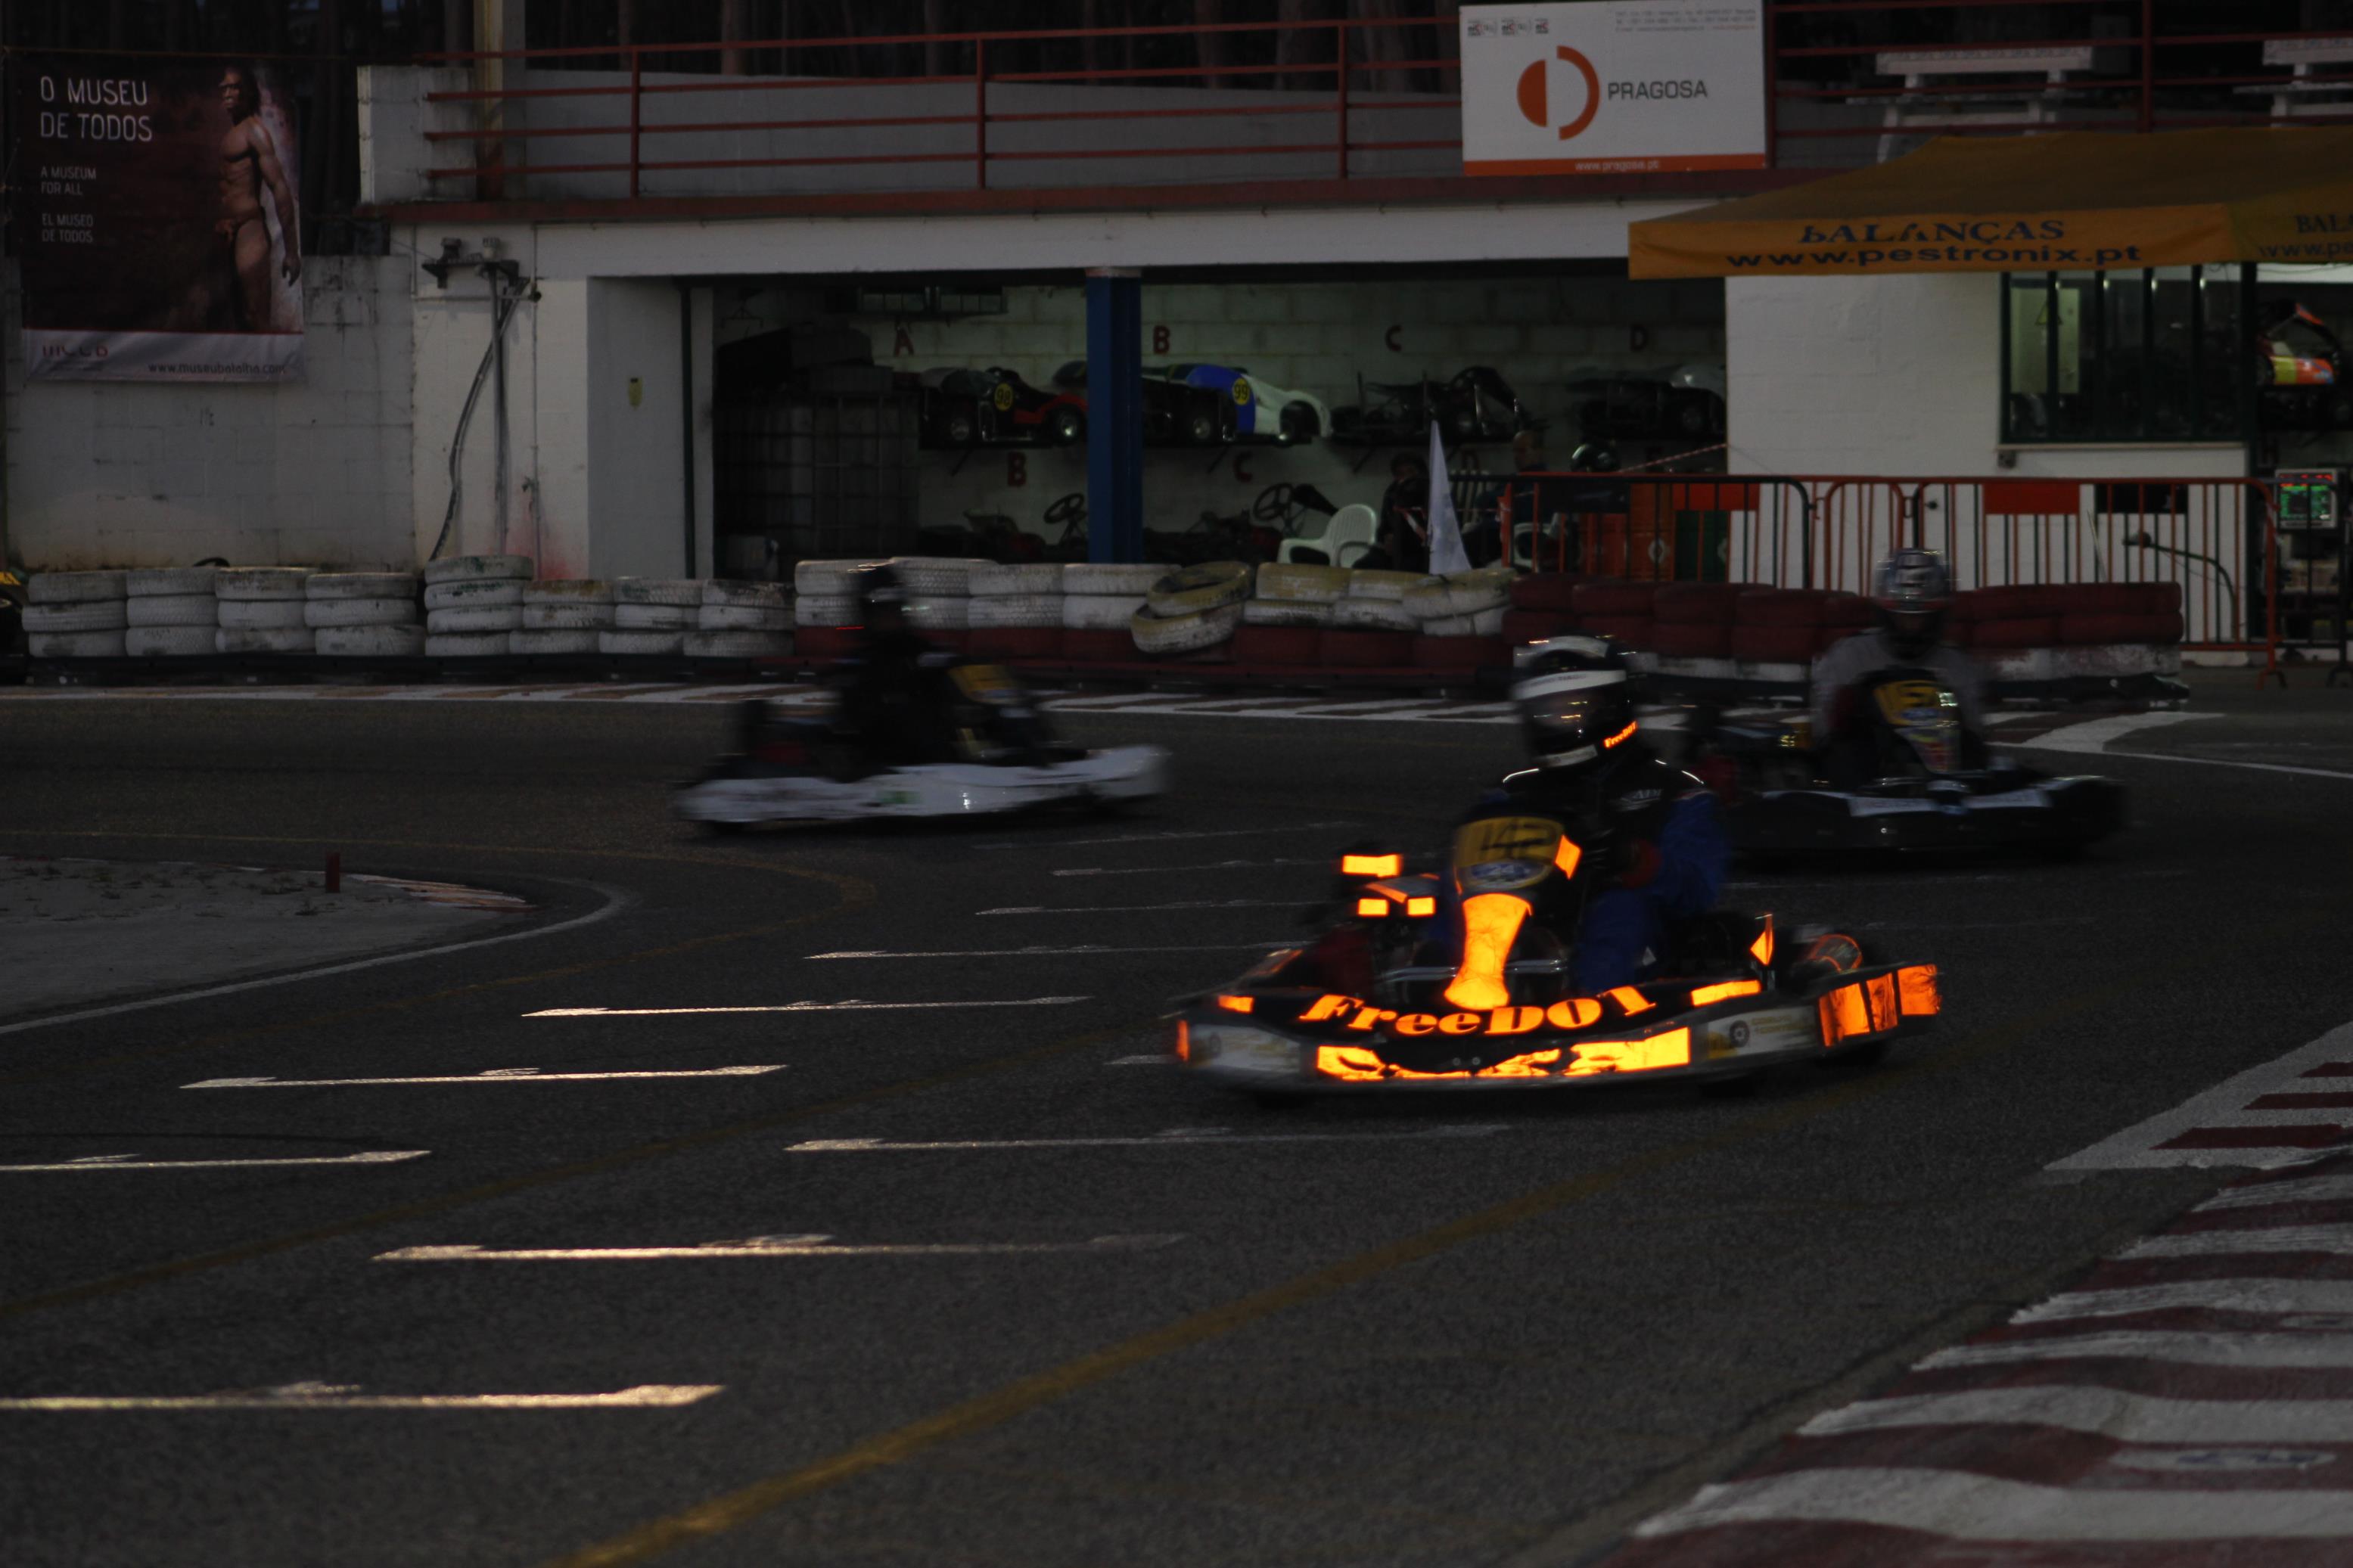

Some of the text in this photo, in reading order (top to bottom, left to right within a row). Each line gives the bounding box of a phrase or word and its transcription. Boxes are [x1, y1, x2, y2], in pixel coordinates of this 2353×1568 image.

[40, 76, 148, 106] O MUSEU
[1608, 80, 1708, 100] PRAGOSA
[40, 112, 153, 142] DE TODOS
[40, 166, 97, 180] A MUSEUM
[41, 182, 84, 196] FOR ALL
[42, 213, 94, 227] EL MUSEO
[42, 228, 94, 244] DE TODOS
[1727, 245, 2142, 266] www.pestronix.pt
[1153, 326, 1170, 354] B
[1385, 324, 1402, 352] C
[1630, 324, 1648, 351] D
[1007, 452, 1026, 486] B
[1298, 985, 1657, 1036] FreeDOT
